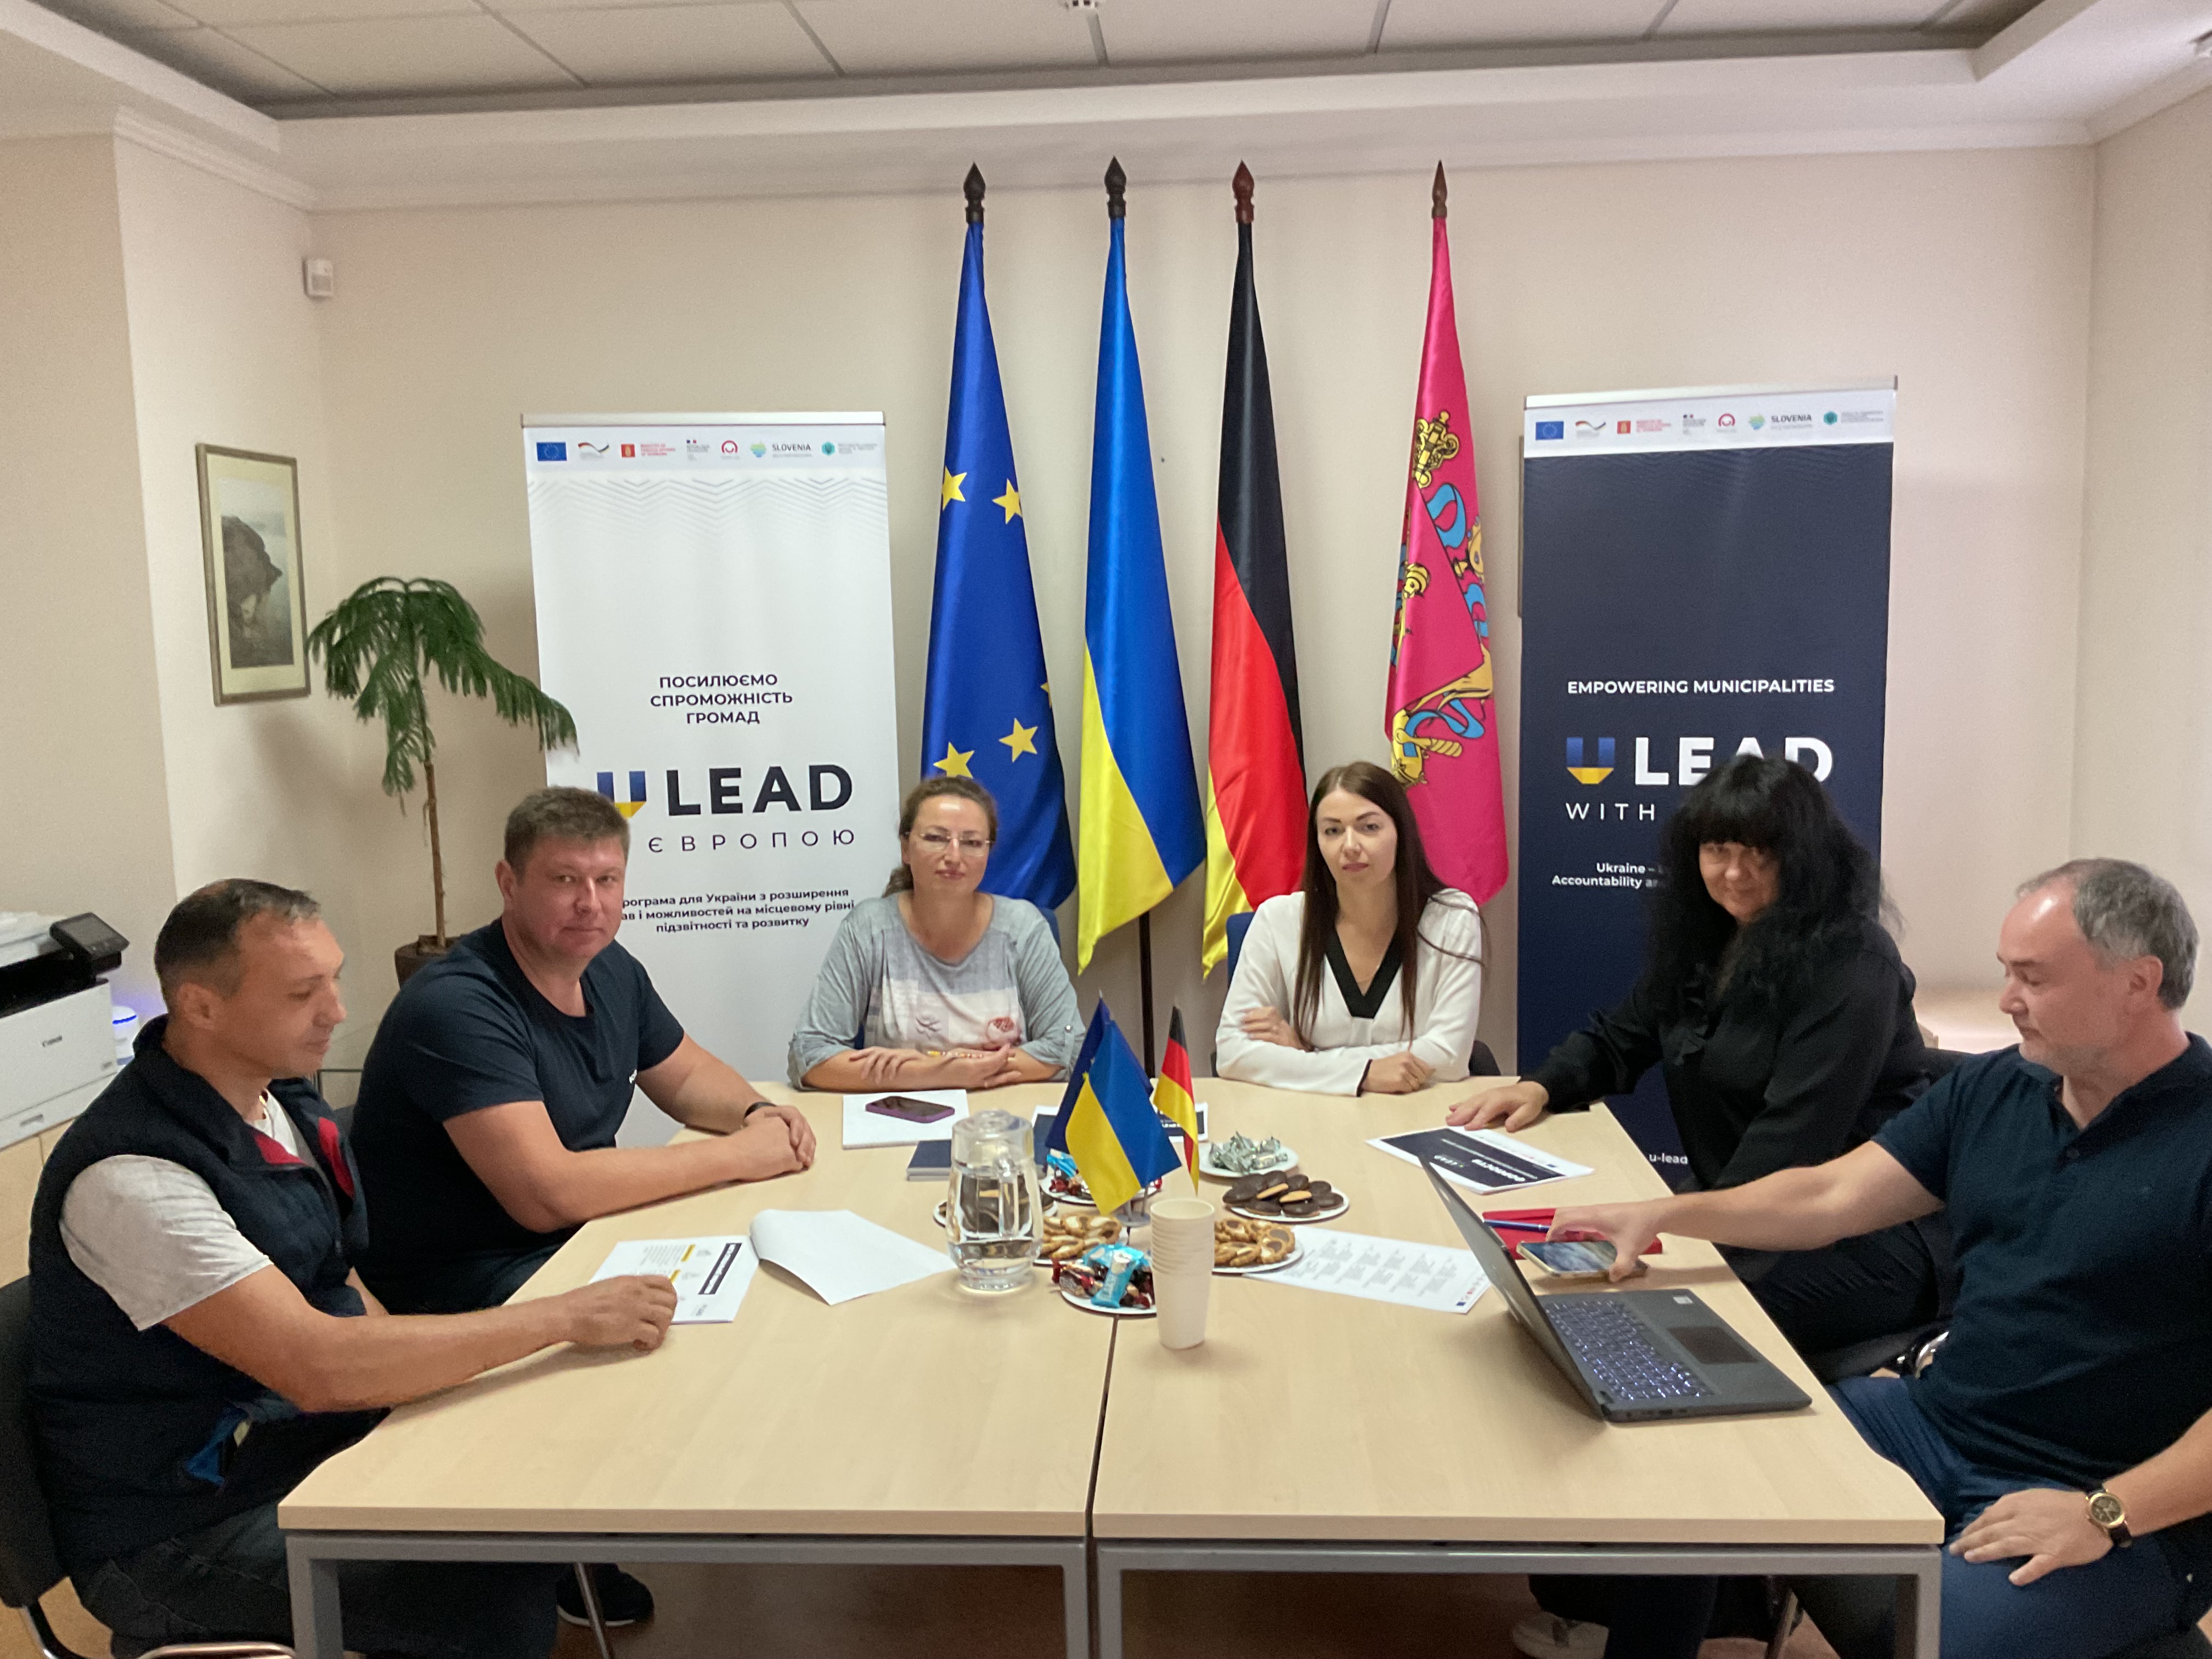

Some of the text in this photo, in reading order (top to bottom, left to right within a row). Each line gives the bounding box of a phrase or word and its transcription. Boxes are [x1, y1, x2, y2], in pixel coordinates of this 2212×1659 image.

[1771, 414, 1812, 423] SLOVENIA
[772, 443, 811, 452] SLOVENIA
[659, 674, 778, 689] ПОСИЛЮЄМО
[1567, 679, 1835, 694] EMPOWERING MUNICIPALITIES
[650, 692, 793, 707] СПРОМОЖНІСТЬ
[686, 711, 760, 724] ГРОМАД
[666, 764, 853, 816] LEAD
[1566, 803, 1655, 821] WITH
[648, 829, 854, 853] ЄВРОПОЮ
[1596, 862, 1646, 874] Ukraine
[1551, 874, 1643, 890] Accountability
[622, 898, 676, 909] рограма
[679, 895, 703, 906] для
[706, 891, 757, 904] України
[770, 889, 849, 901] розширення
[646, 905, 733, 919] можливостей
[755, 900, 822, 915] місцевому
[656, 917, 809, 933] підзвітності та розвитку
